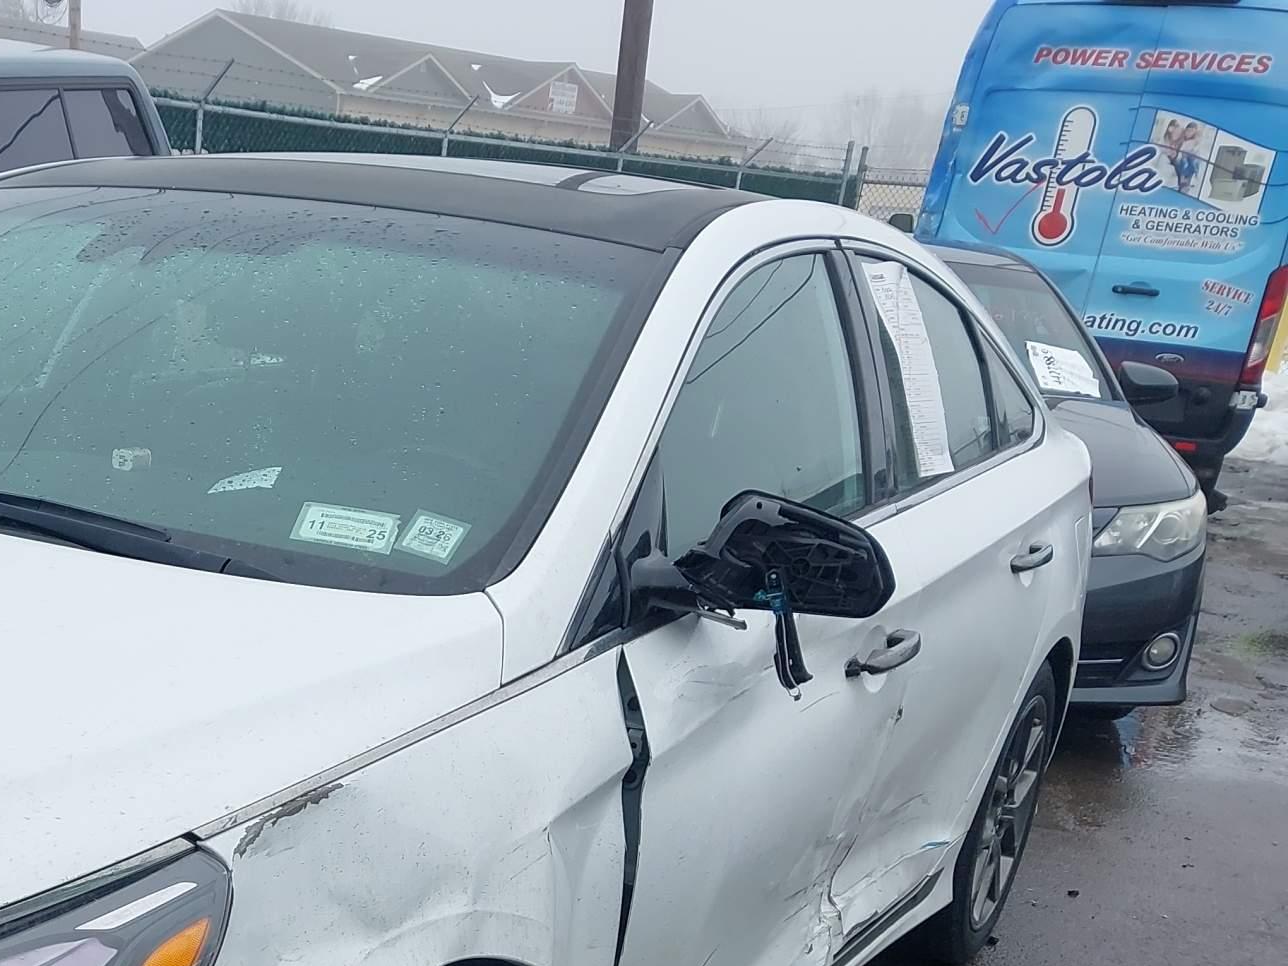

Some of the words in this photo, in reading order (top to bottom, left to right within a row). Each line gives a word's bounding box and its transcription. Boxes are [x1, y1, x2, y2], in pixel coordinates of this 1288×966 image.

[1033, 47, 1130, 69] POWER
[1135, 50, 1273, 75] SERVICES
[969, 132, 1163, 193] Vastola
[1119, 205, 1179, 219] HEATING
[1181, 209, 1191, 220] &
[1195, 211, 1259, 226] COOLING
[1131, 218, 1141, 229] &
[1145, 220, 1239, 238] GENERATORS
[1143, 235, 1198, 248] Comfortable
[1200, 240, 1221, 250] With
[1201, 279, 1254, 304] SERVICE
[1205, 300, 1233, 316] 24/7
[308, 519, 325, 530] 11
[366, 529, 387, 541] 25
